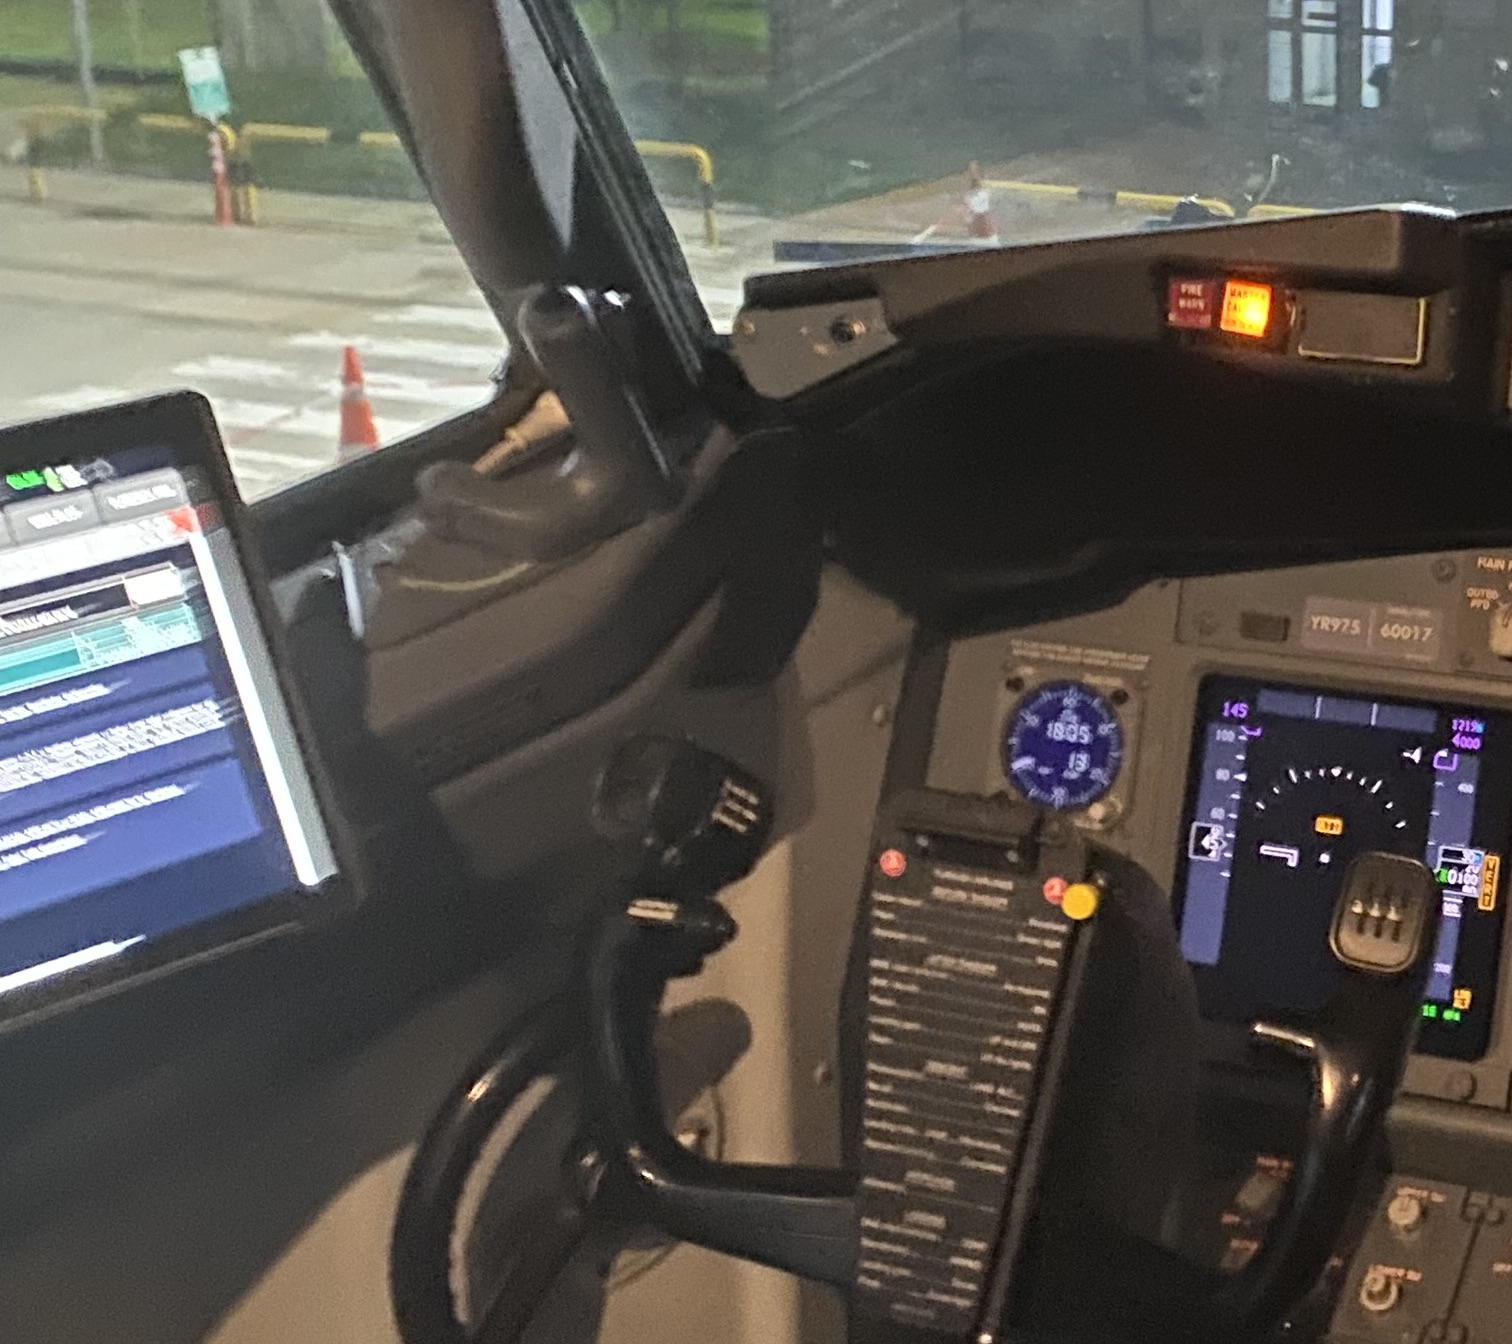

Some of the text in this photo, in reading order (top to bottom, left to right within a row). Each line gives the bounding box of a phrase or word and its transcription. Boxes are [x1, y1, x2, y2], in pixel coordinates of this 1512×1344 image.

[1311, 615, 1360, 635] YR975
[1380, 623, 1432, 641] 60017
[1222, 701, 1249, 718] 145
